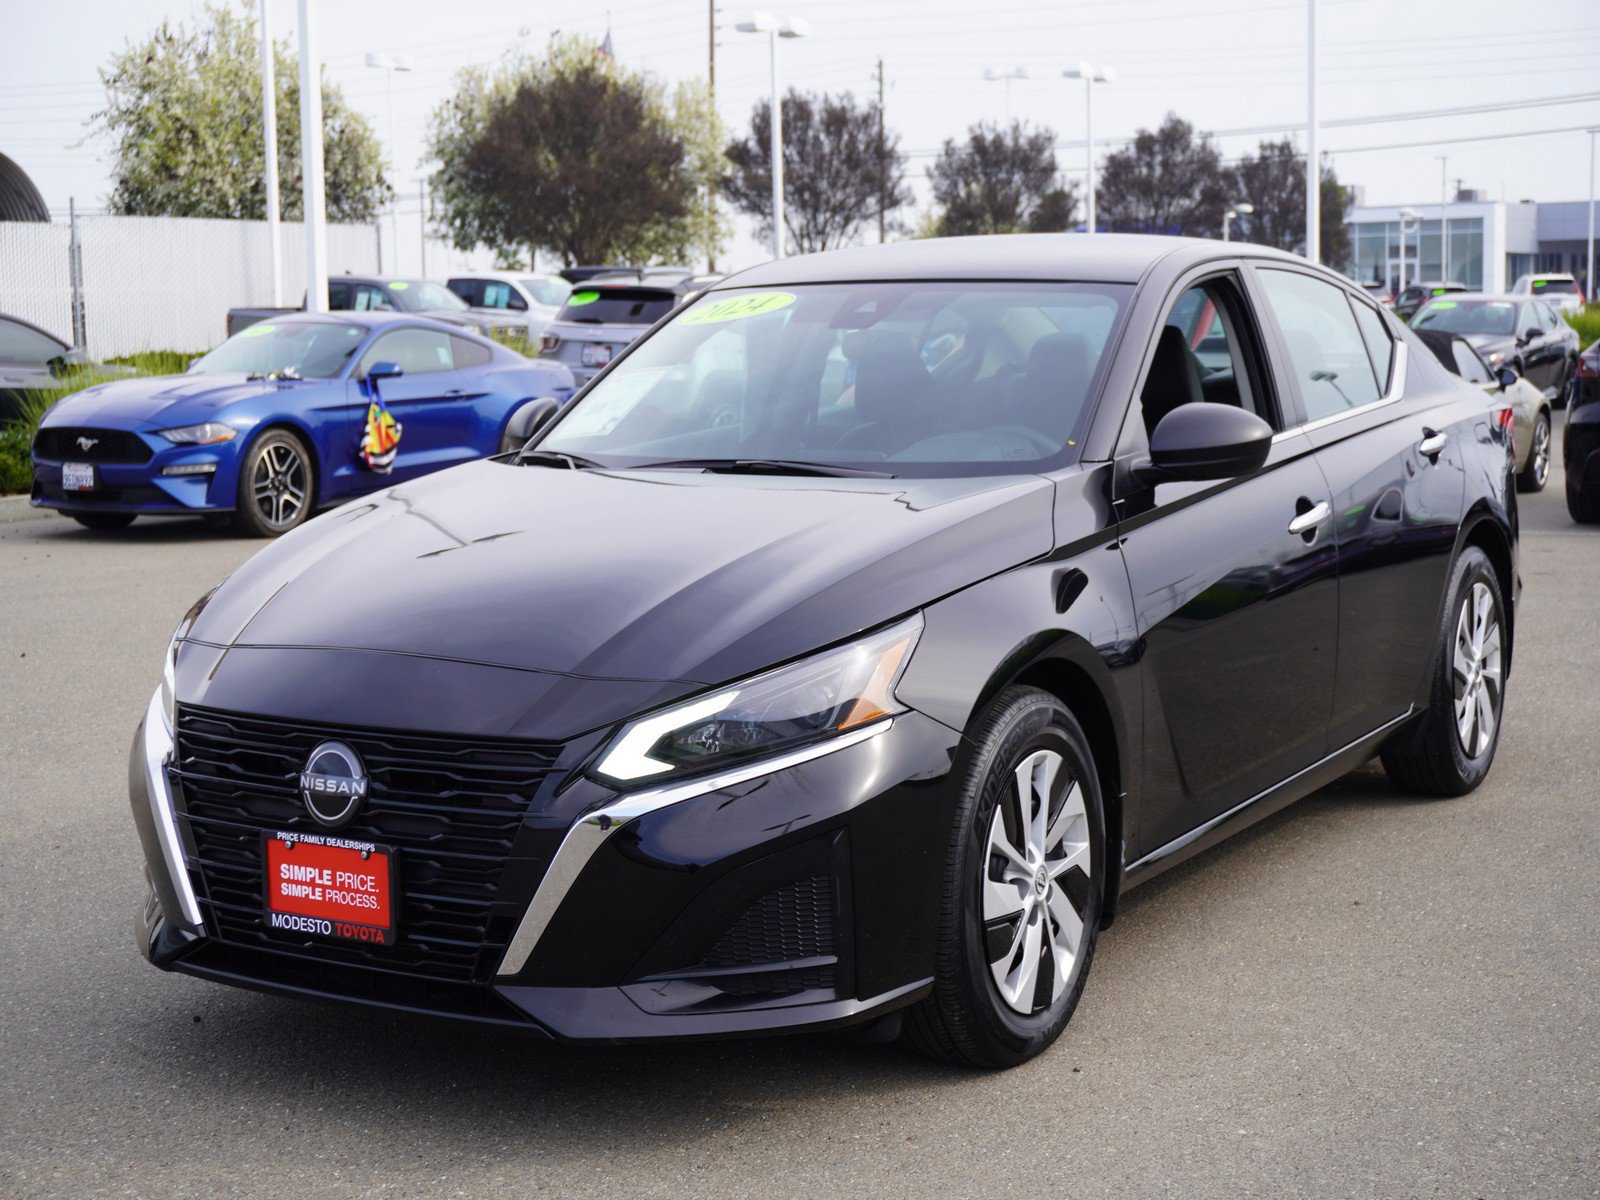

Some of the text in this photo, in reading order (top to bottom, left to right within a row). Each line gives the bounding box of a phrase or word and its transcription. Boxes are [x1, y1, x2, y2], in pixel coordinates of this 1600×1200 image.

[689, 295, 779, 321] 2024
[300, 776, 364, 794] NISSAN
[277, 832, 375, 852] PRICE FAMILY DEALERSHIPS
[280, 863, 379, 892] SIMPLE PRICE.
[281, 883, 380, 909] SIMPLE PROCESS.
[272, 914, 384, 943] MODESTO TOYOTA
